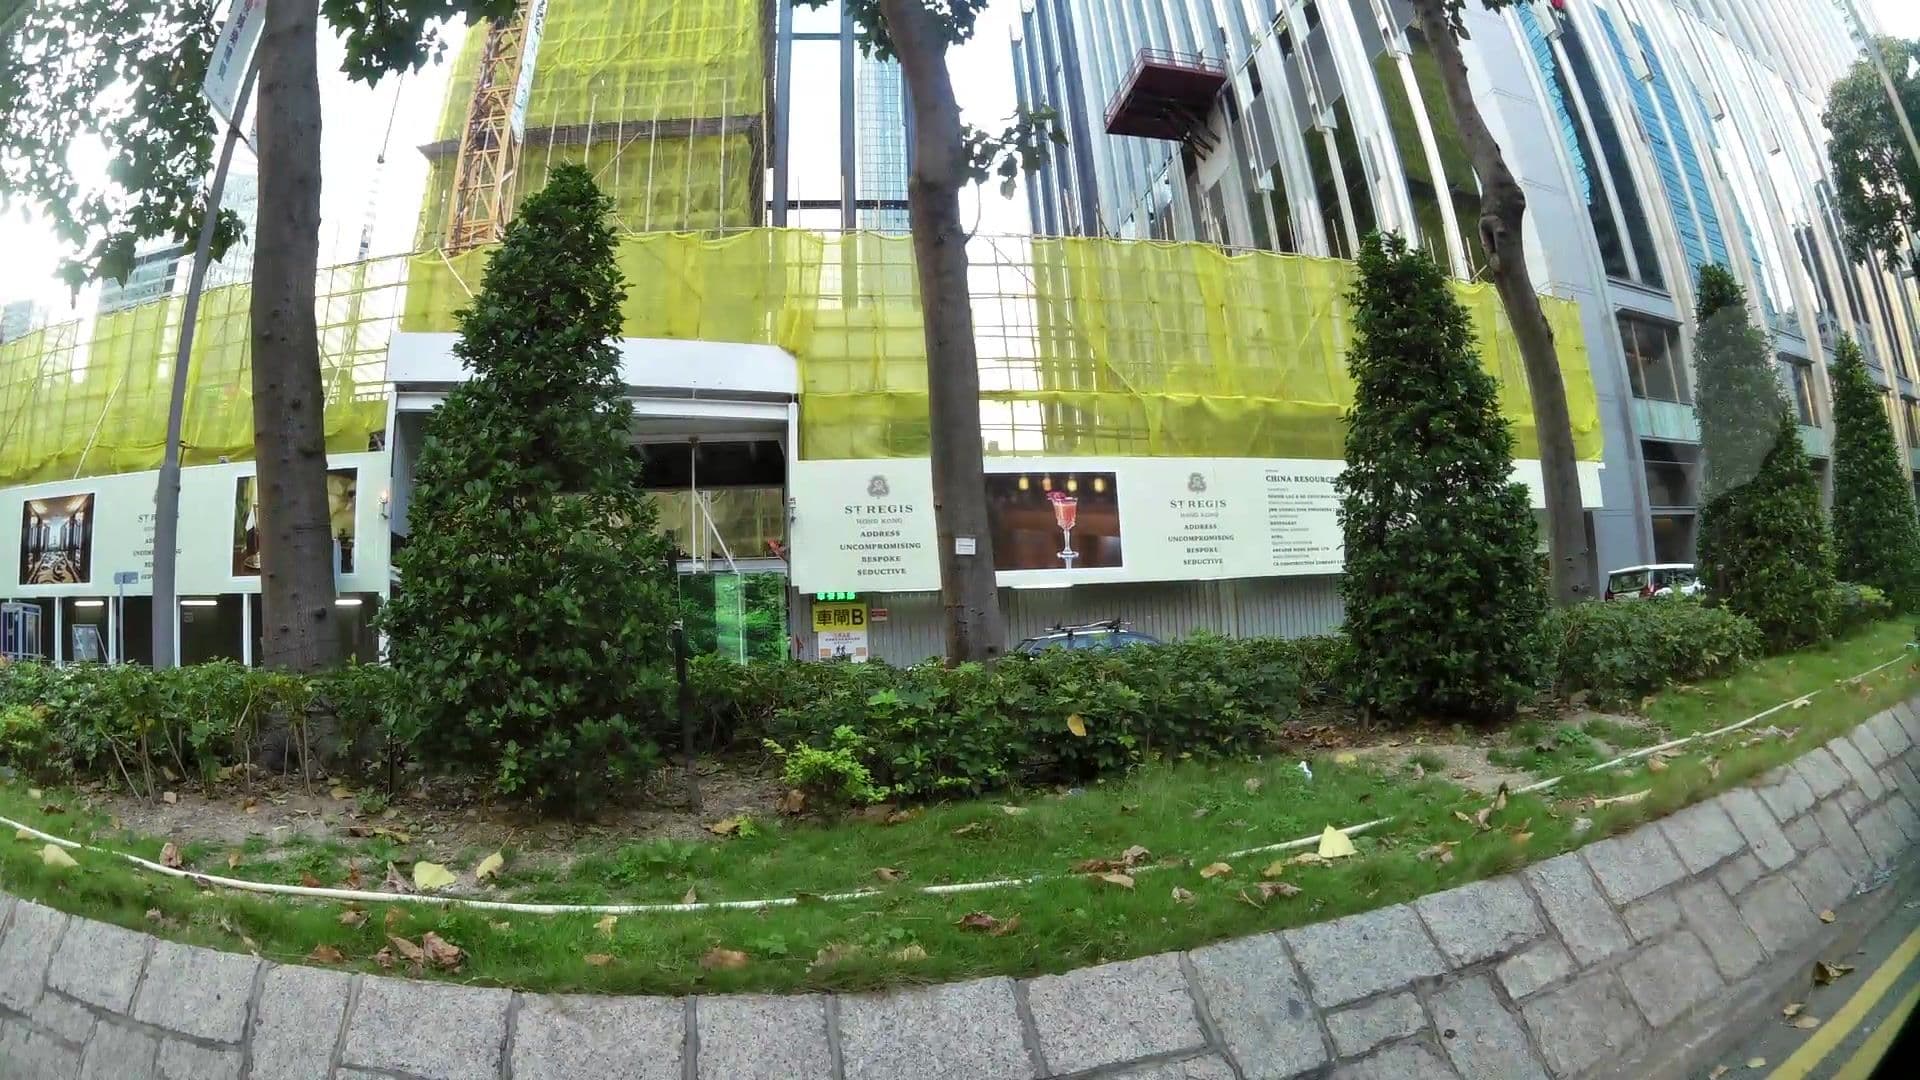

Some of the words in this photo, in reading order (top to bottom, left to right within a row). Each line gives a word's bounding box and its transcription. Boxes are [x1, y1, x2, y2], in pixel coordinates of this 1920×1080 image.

[1170, 499, 1185, 508] ST
[1188, 499, 1227, 508] REGIS
[844, 505, 862, 514] ST
[867, 504, 913, 514] REGIS
[857, 567, 907, 576] SEDUCTIVE
